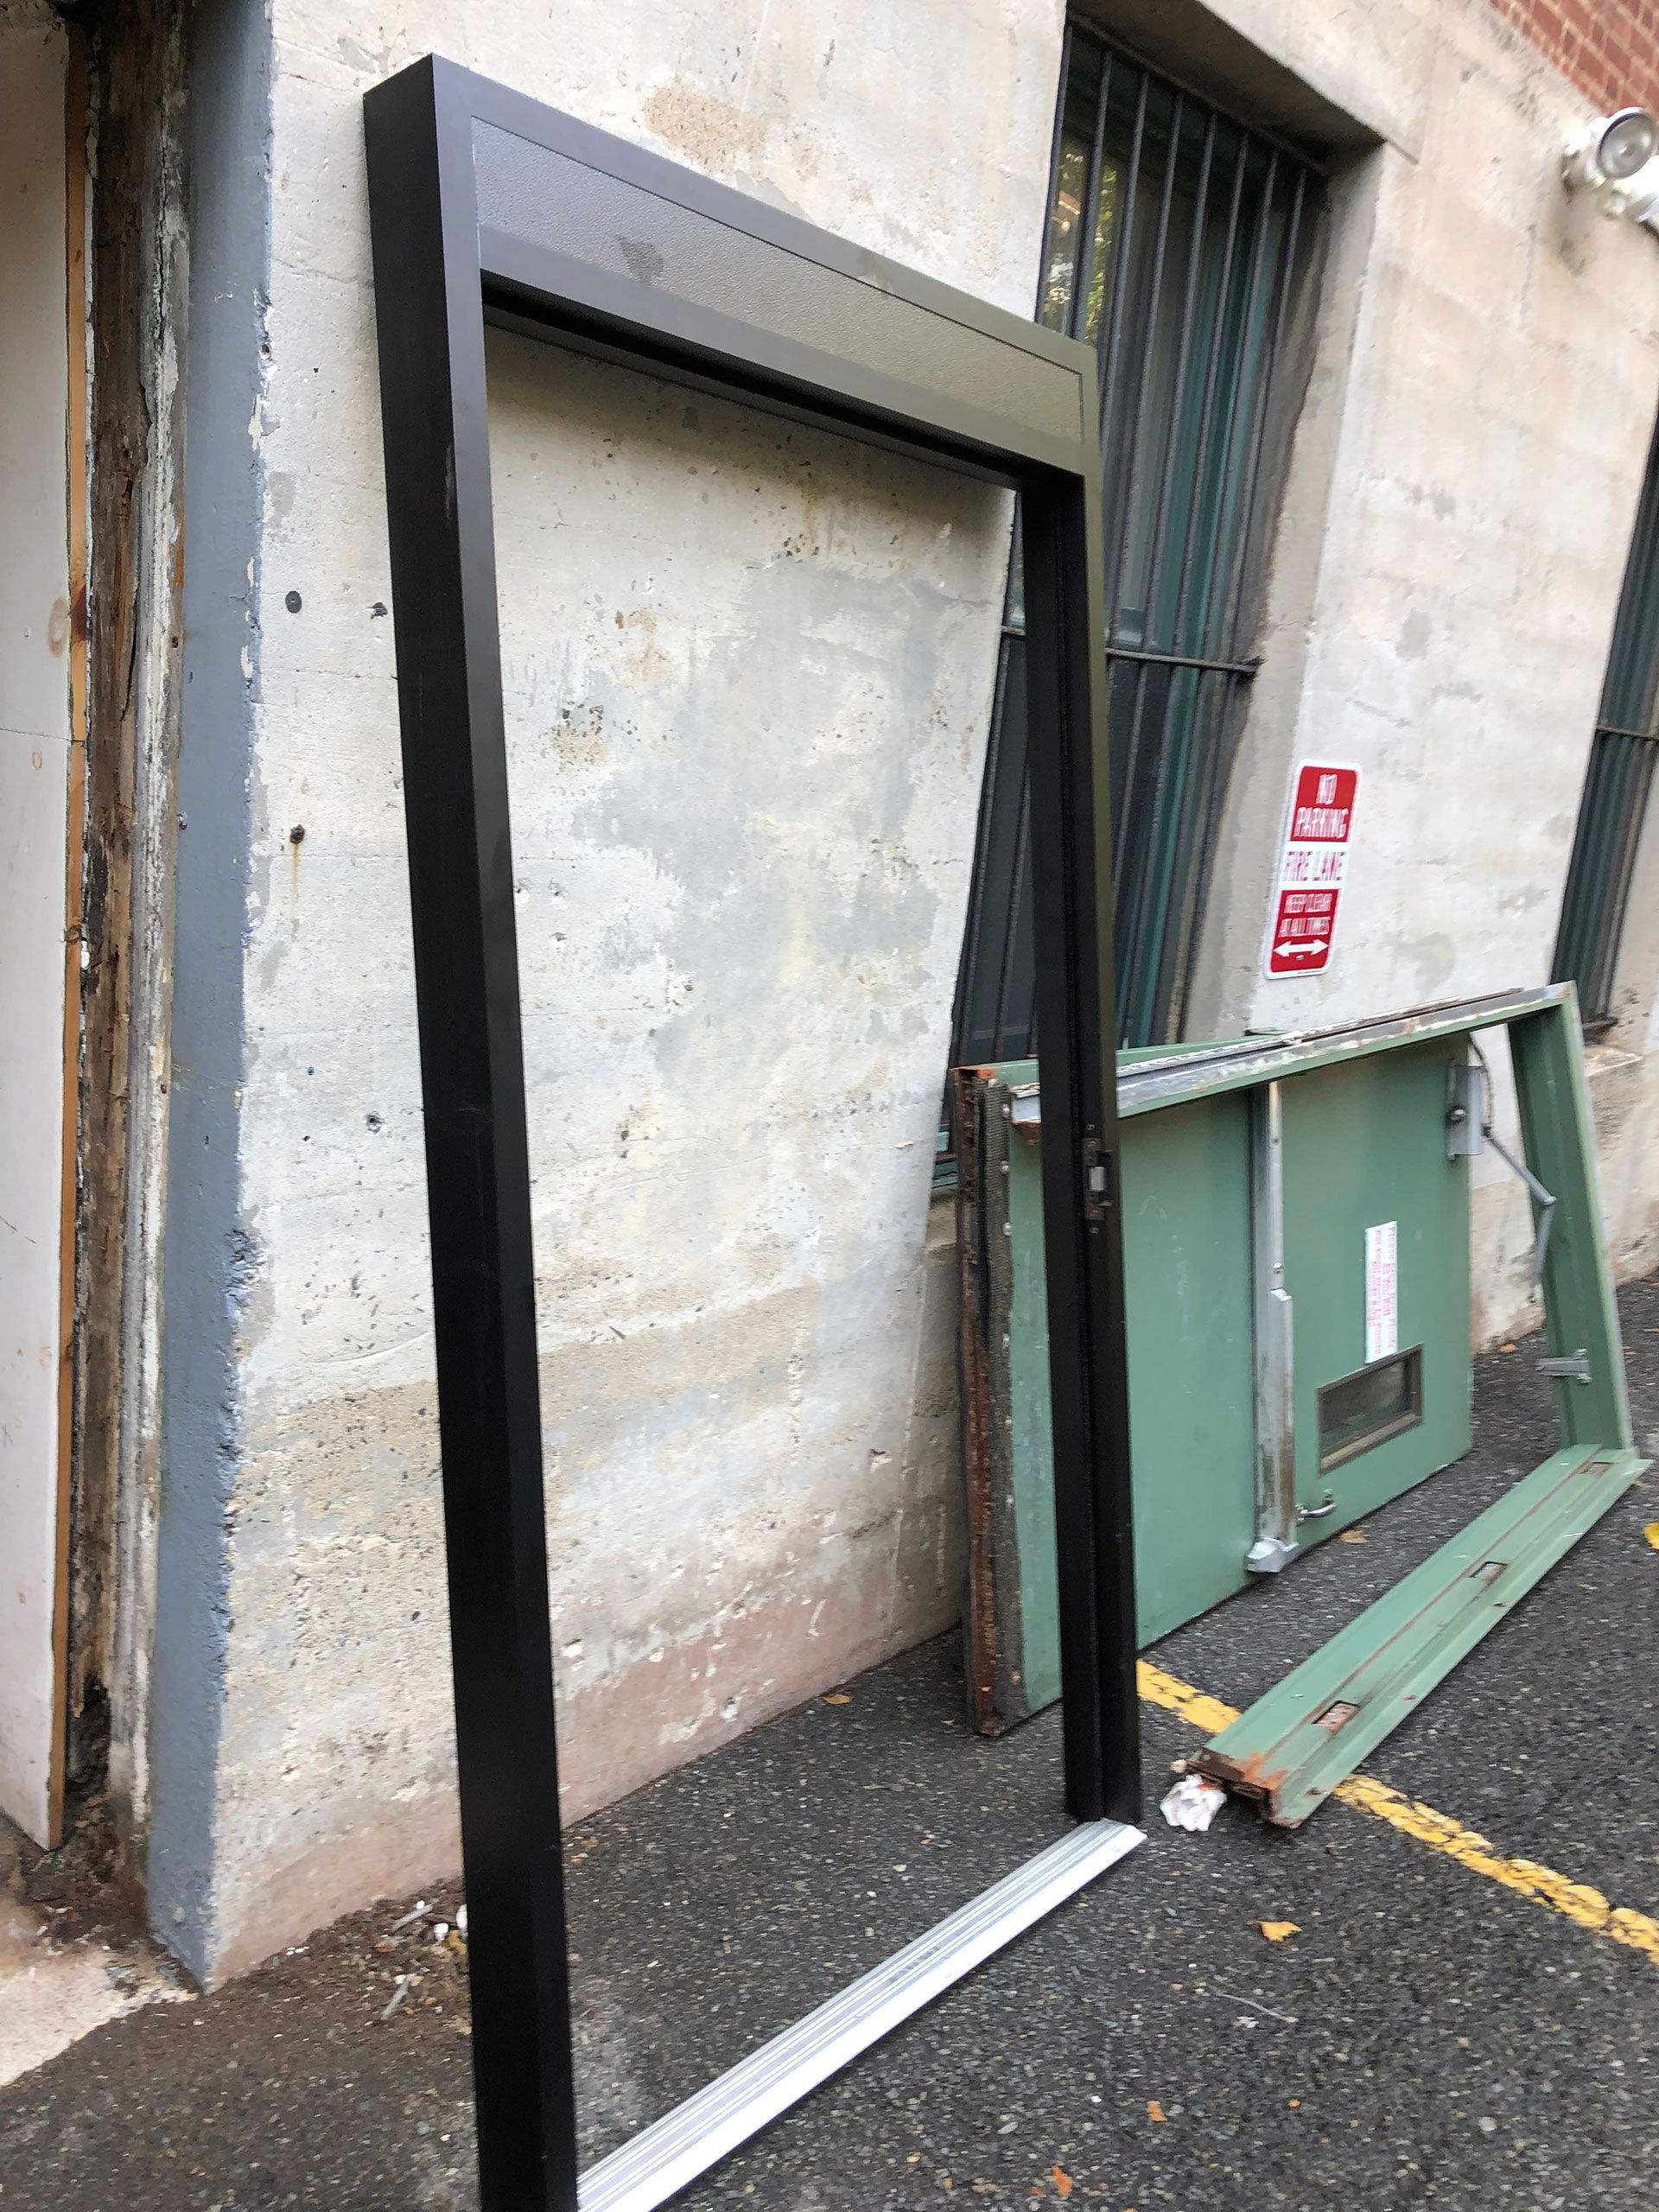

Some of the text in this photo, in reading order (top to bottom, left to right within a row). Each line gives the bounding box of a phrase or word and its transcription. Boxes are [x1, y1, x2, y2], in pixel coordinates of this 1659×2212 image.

[1316, 773, 1338, 804] NO
[1294, 806, 1349, 838] PARKING
[1283, 851, 1346, 881] FIRE LANE
